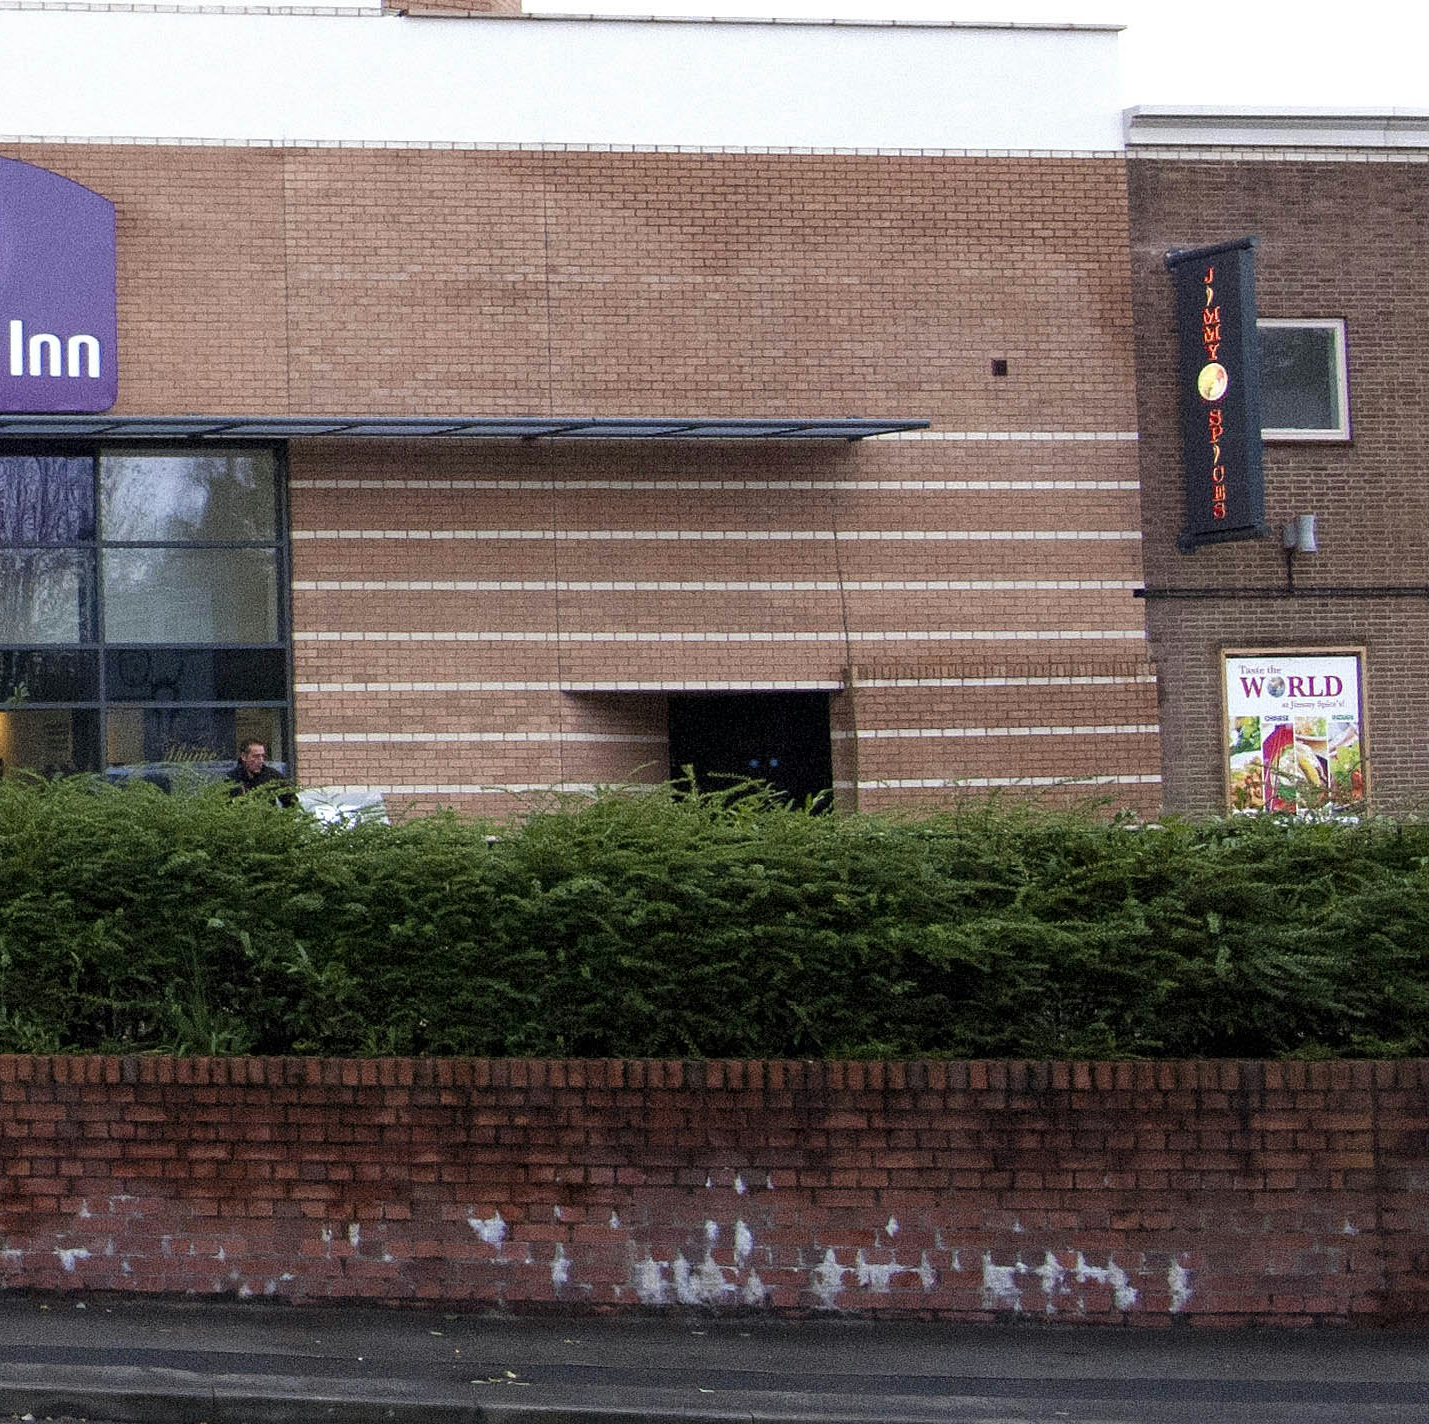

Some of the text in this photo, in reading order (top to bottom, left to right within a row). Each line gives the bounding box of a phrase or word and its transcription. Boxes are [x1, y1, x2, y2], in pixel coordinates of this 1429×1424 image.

[10, 319, 101, 379] Inn
[1201, 266, 1226, 520] JIMMY SPICES
[1239, 664, 1281, 674] Taste the
